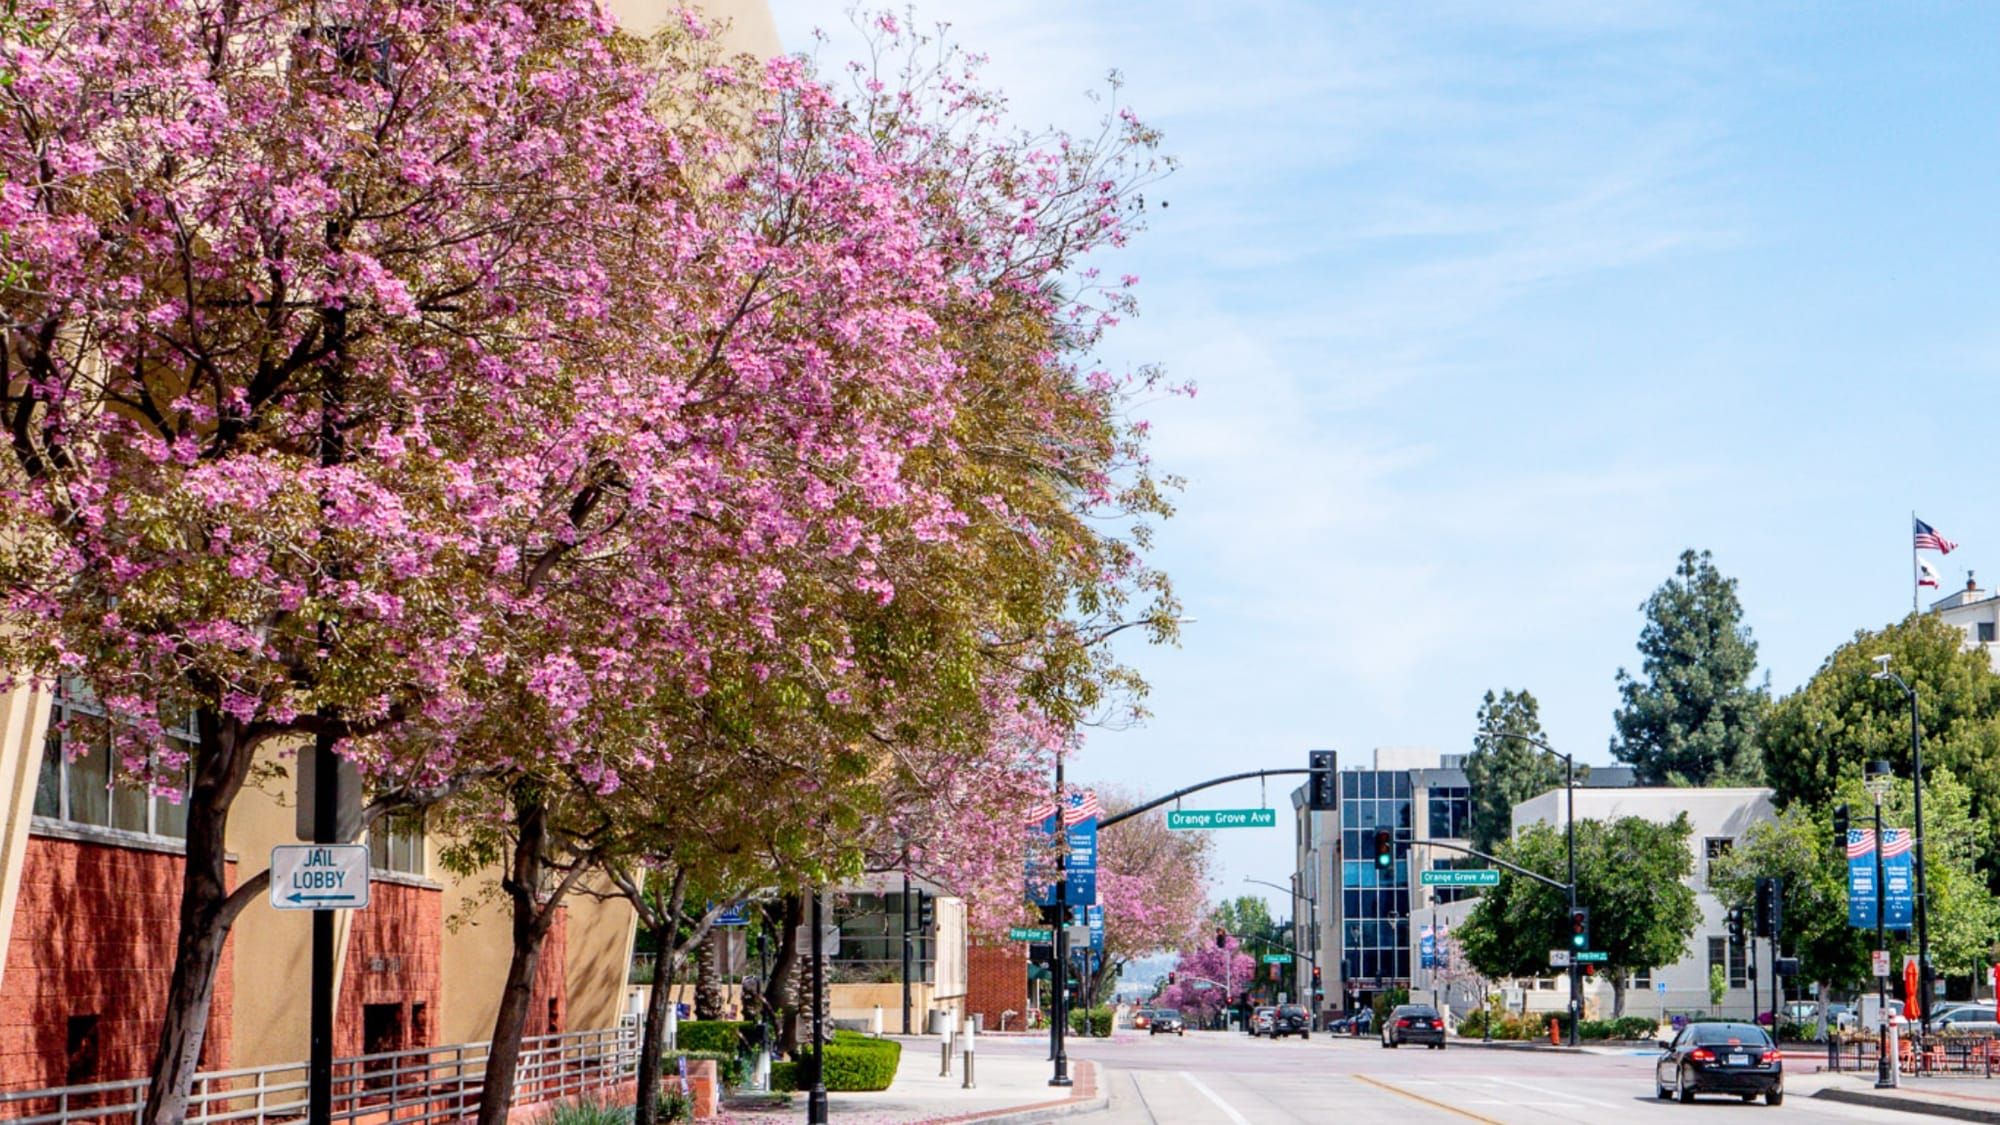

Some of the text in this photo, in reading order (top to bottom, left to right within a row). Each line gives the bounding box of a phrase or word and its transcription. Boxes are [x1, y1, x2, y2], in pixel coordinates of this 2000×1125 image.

[1172, 811, 1271, 826] Orange Grove Ave
[303, 849, 337, 867] JAIL
[293, 871, 346, 889] LOBBY
[1424, 873, 1495, 883] Orange Grove Ave
